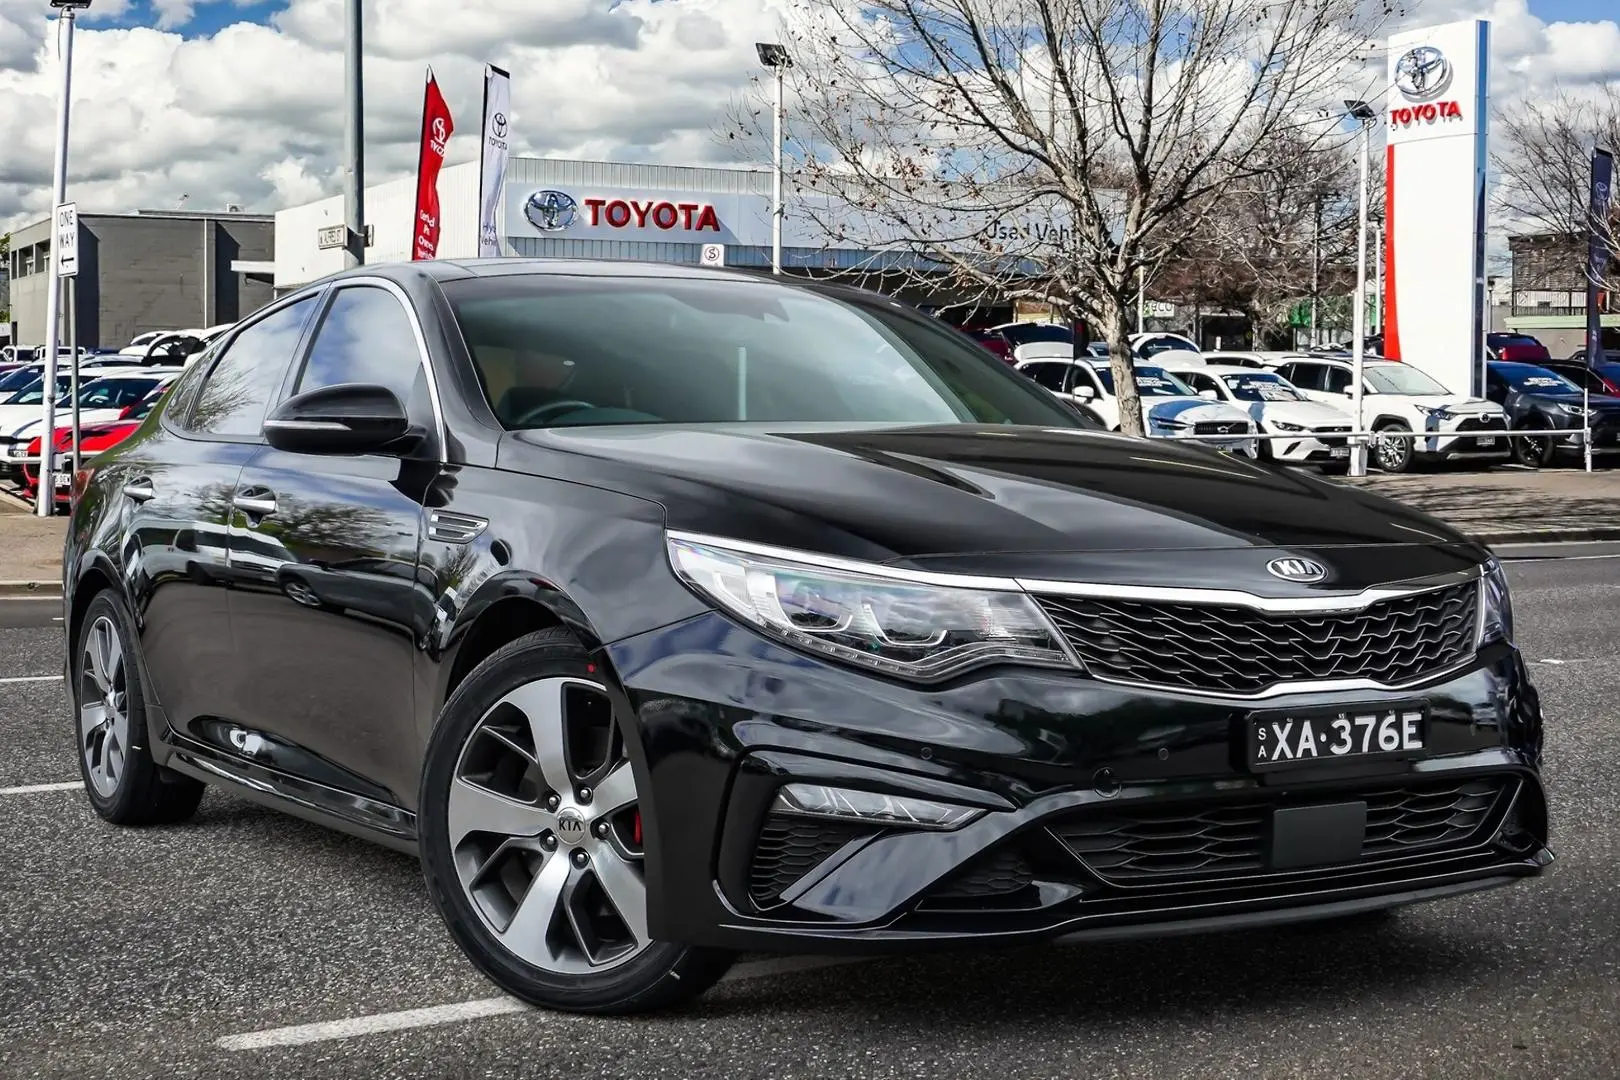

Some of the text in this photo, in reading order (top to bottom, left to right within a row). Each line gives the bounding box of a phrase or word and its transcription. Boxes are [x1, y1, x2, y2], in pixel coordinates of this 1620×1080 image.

[1389, 101, 1462, 125] TOYOTA
[60, 209, 74, 227] ONE
[585, 199, 720, 231] TOYOTA
[60, 231, 75, 248] WAY
[1274, 559, 1322, 575] KIA
[558, 820, 582, 832] KIA
